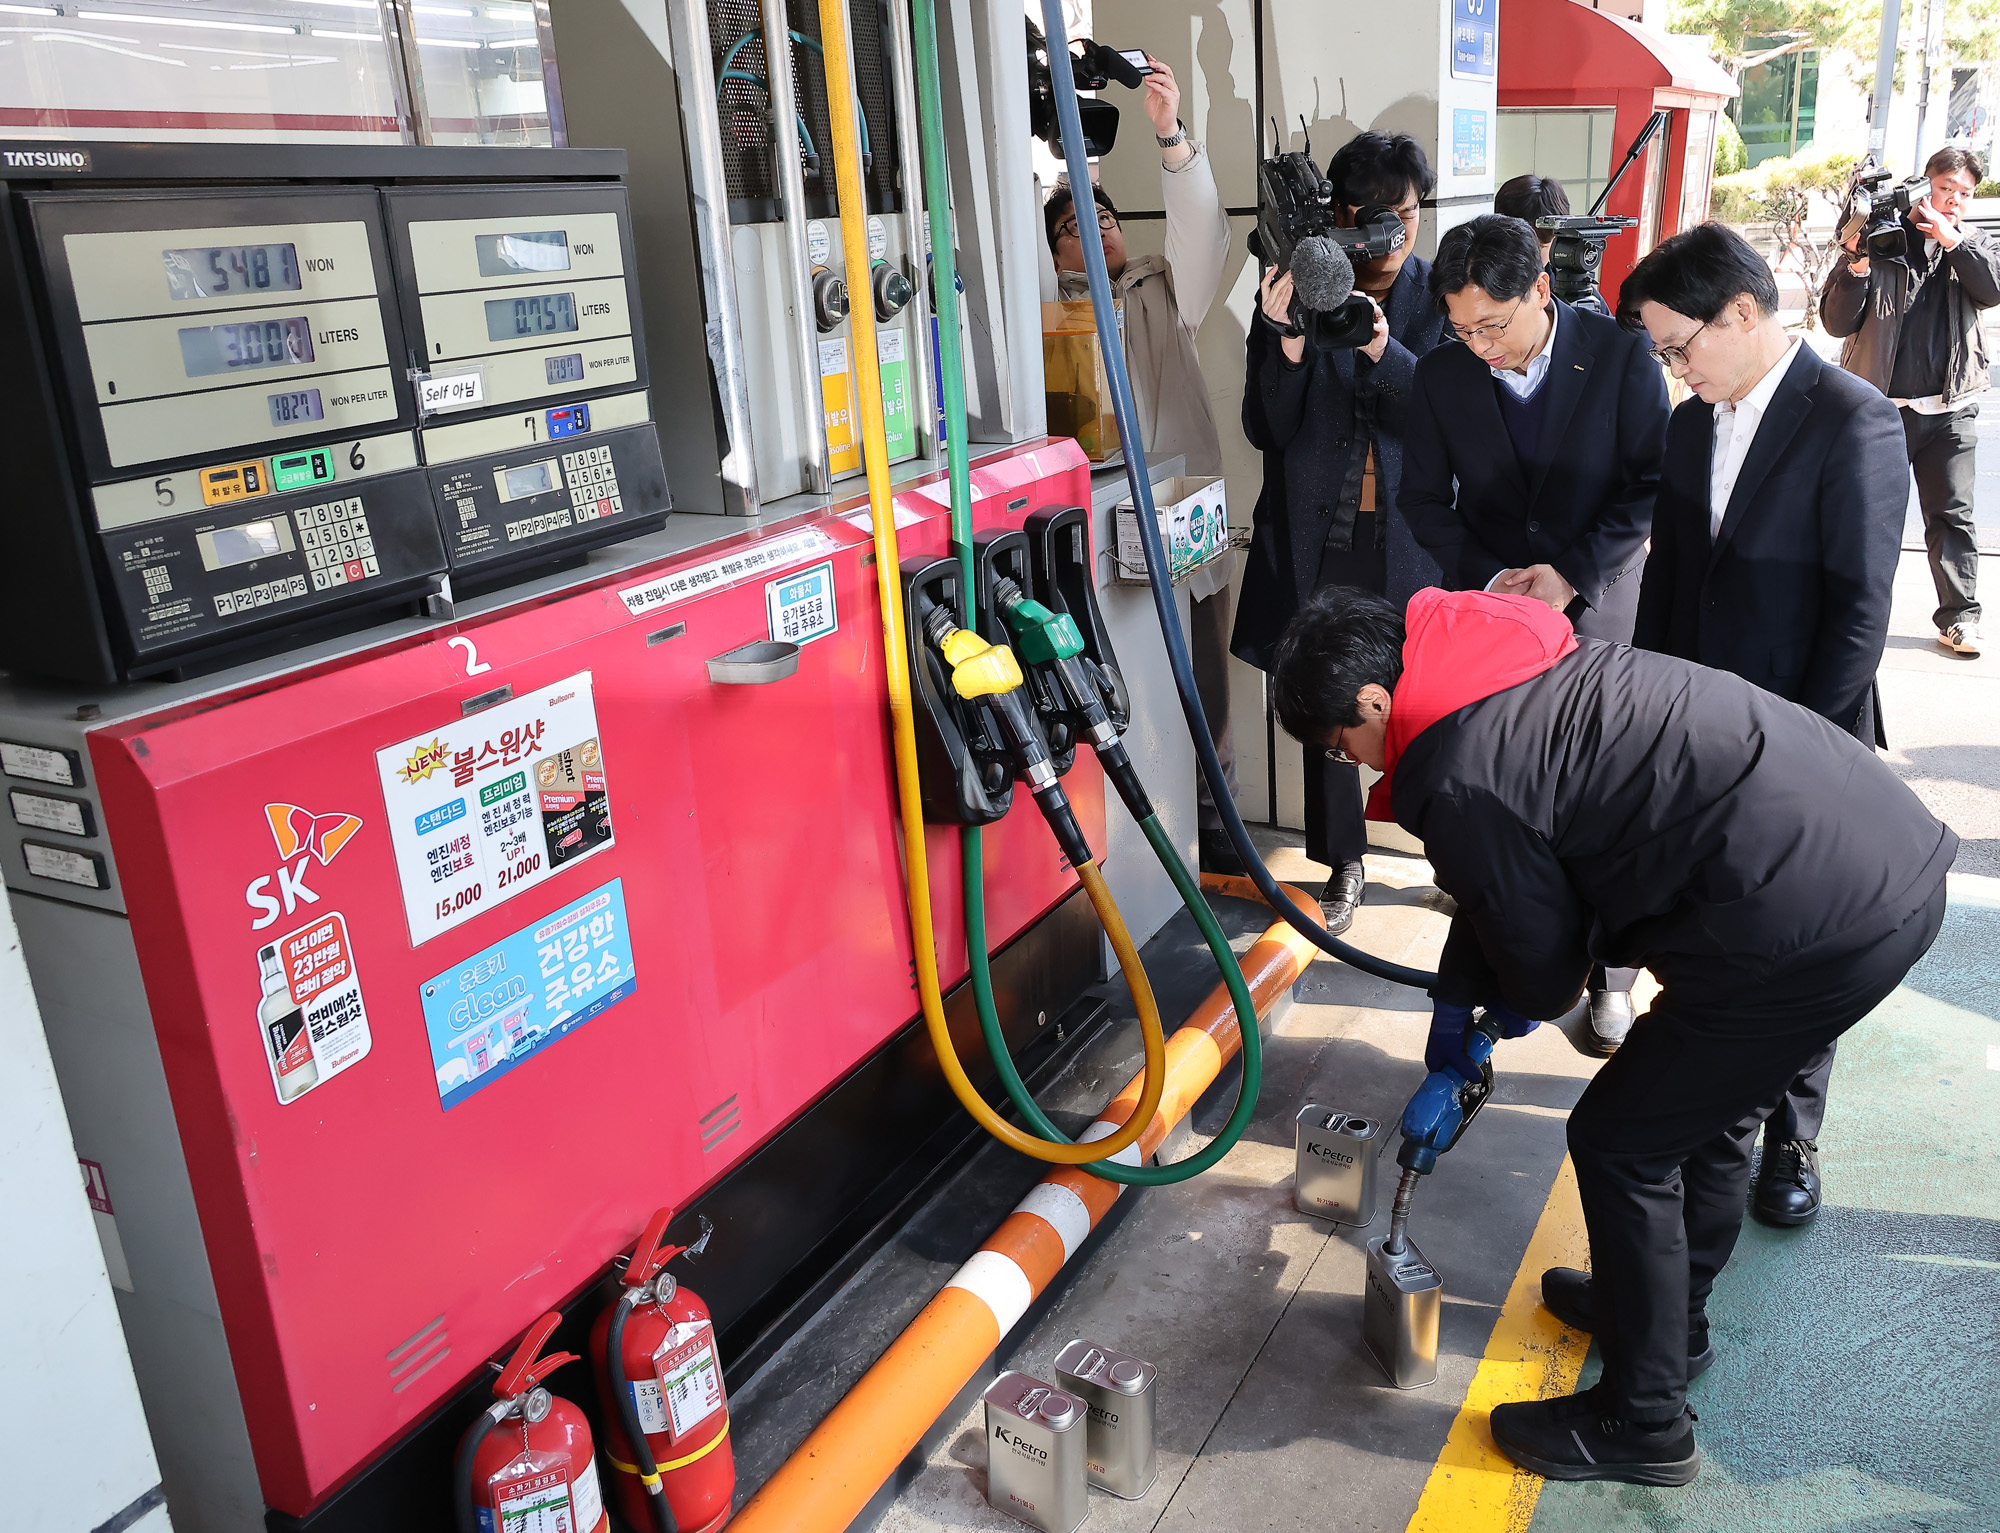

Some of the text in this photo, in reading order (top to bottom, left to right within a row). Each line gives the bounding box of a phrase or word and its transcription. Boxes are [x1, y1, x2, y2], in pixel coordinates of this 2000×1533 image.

[5, 151, 85, 167] TATSUNO
[573, 244, 595, 256] WON
[1390, 229, 1406, 250] KBS
[210, 246, 291, 292] 5481
[305, 258, 335, 272] WON
[514, 298, 572, 334] 0.757
[582, 303, 611, 317] LITERS
[318, 328, 359, 344] LITERS
[589, 356, 630, 369] WON PER LITER
[330, 391, 388, 406] WON PER LITER
[426, 381, 476, 402] Self 아님
[275, 393, 310, 421] 1827
[525, 416, 536, 441] 7
[349, 442, 365, 471] 6
[565, 456, 572, 468] 7
[578, 454, 584, 465] 8
[591, 451, 597, 462] 9
[602, 449, 608, 460] #
[1024, 452, 1044, 476] 7
[570, 474, 577, 485] 4
[582, 471, 589, 482] 5
[594, 468, 601, 480] 6
[155, 477, 176, 506] 5
[211, 484, 242, 497] 휘발유
[574, 486, 605, 502] 1 2 3
[300, 512, 308, 525] 7
[318, 508, 327, 522] 8
[334, 505, 343, 518] 9
[351, 502, 359, 514] #
[578, 499, 620, 520] 0 C L
[306, 532, 315, 545] 4
[323, 529, 332, 541] 5
[340, 525, 348, 537] 6
[508, 513, 571, 538] P1 P2 P3 P4 P5
[312, 545, 354, 566] 1 2 3
[317, 561, 376, 586] 0 C L
[217, 579, 306, 612] P1 P2 P3 P4 P5
[626, 594, 645, 608] 차량
[645, 585, 670, 602] 진입시
[671, 579, 688, 594] 다른
[688, 569, 718, 587] 생각말고
[789, 581, 813, 600] 화물차
[782, 597, 823, 624] 유가보조금
[783, 612, 825, 638] 지급 주유소
[447, 635, 493, 677] 2
[548, 691, 576, 707] Bullsone
[406, 745, 445, 778] NEW
[449, 718, 546, 788] 불스원샷
[483, 775, 524, 800] 프리미엄
[543, 794, 576, 803] Premium
[419, 802, 463, 831] 스탠다드
[483, 807, 533, 837] 엔진보호기능
[427, 833, 471, 865] 엔진세정
[430, 852, 475, 883] 엔진보호
[497, 853, 541, 889] 21,000
[246, 855, 320, 930] SK
[436, 883, 482, 920] 15,000
[537, 910, 615, 979] 건강한
[293, 940, 341, 981] 23만원
[545, 949, 620, 1012] 주유소
[308, 989, 358, 1028] 연비에샷
[448, 975, 526, 1031] Clean
[311, 1004, 361, 1043] 불스원샷
[331, 1048, 359, 1069] Bullsone
[1306, 1141, 1354, 1164] K Petro
[995, 1425, 1048, 1460] K Petro
